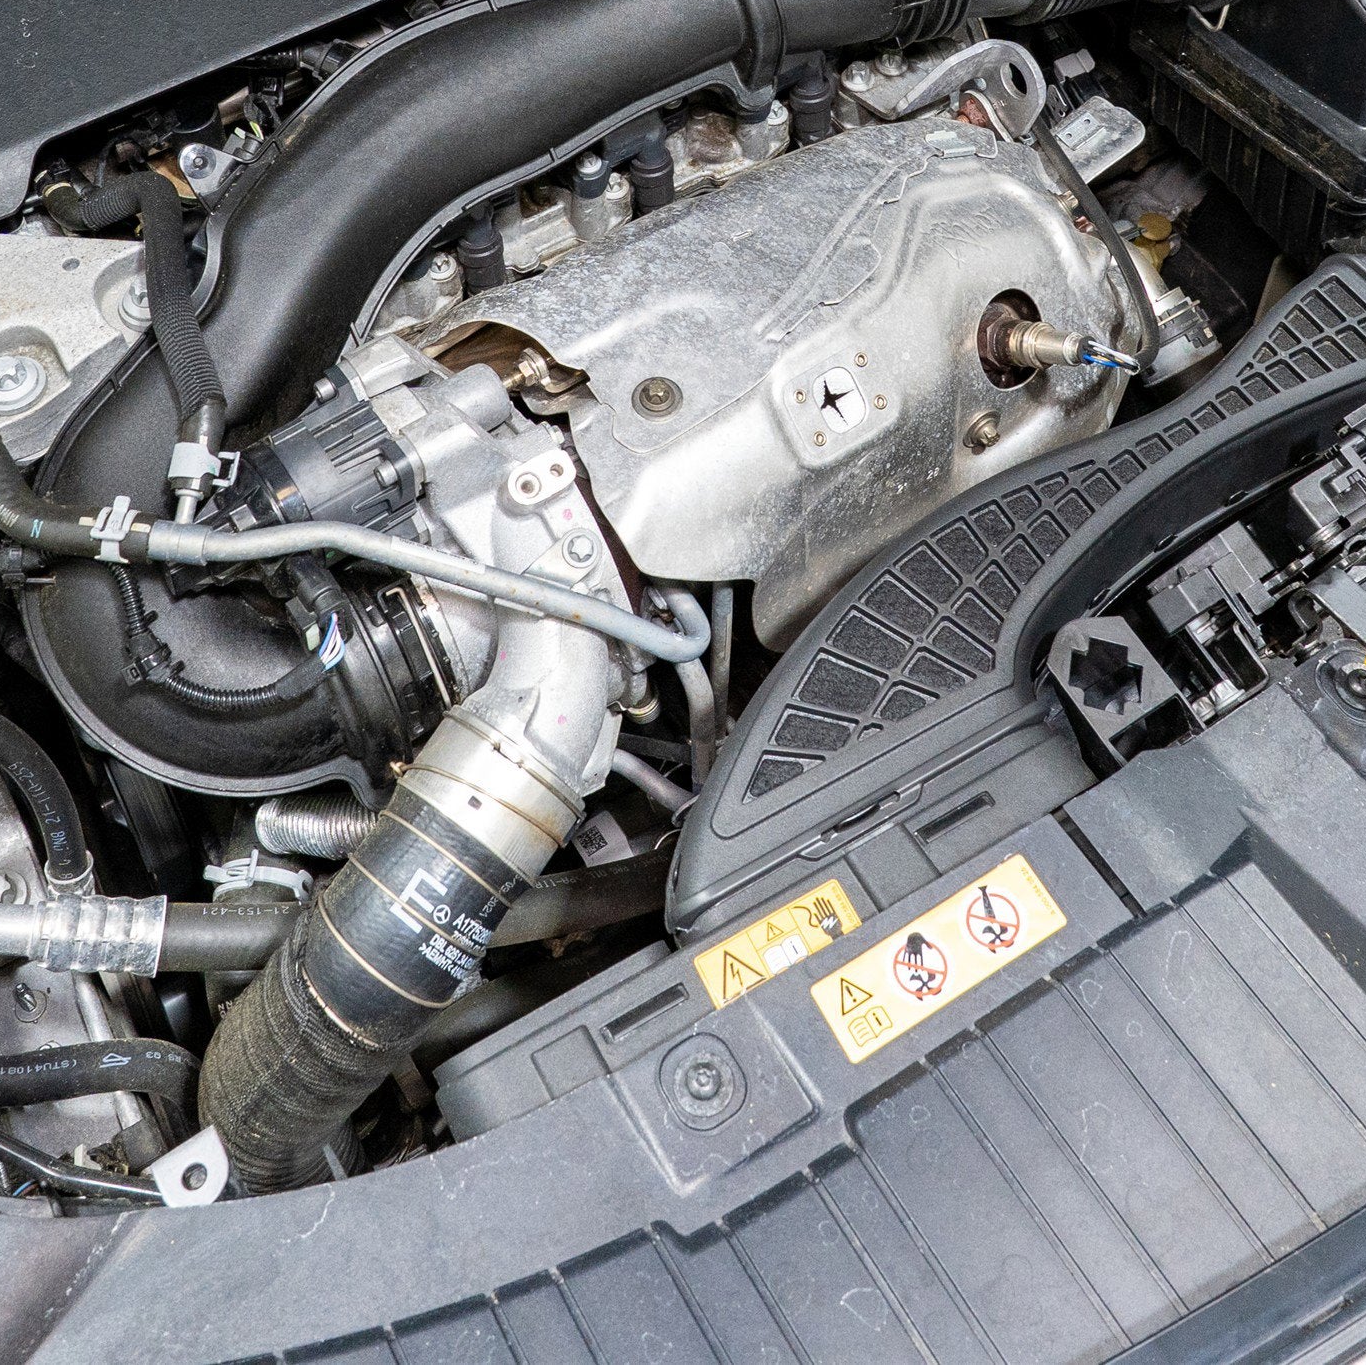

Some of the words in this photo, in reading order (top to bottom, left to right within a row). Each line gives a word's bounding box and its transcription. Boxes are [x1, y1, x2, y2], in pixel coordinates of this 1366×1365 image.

[201, 905, 291, 916] 21-153-421
[388, 867, 449, 935] E
[429, 933, 446, 953] DBL
